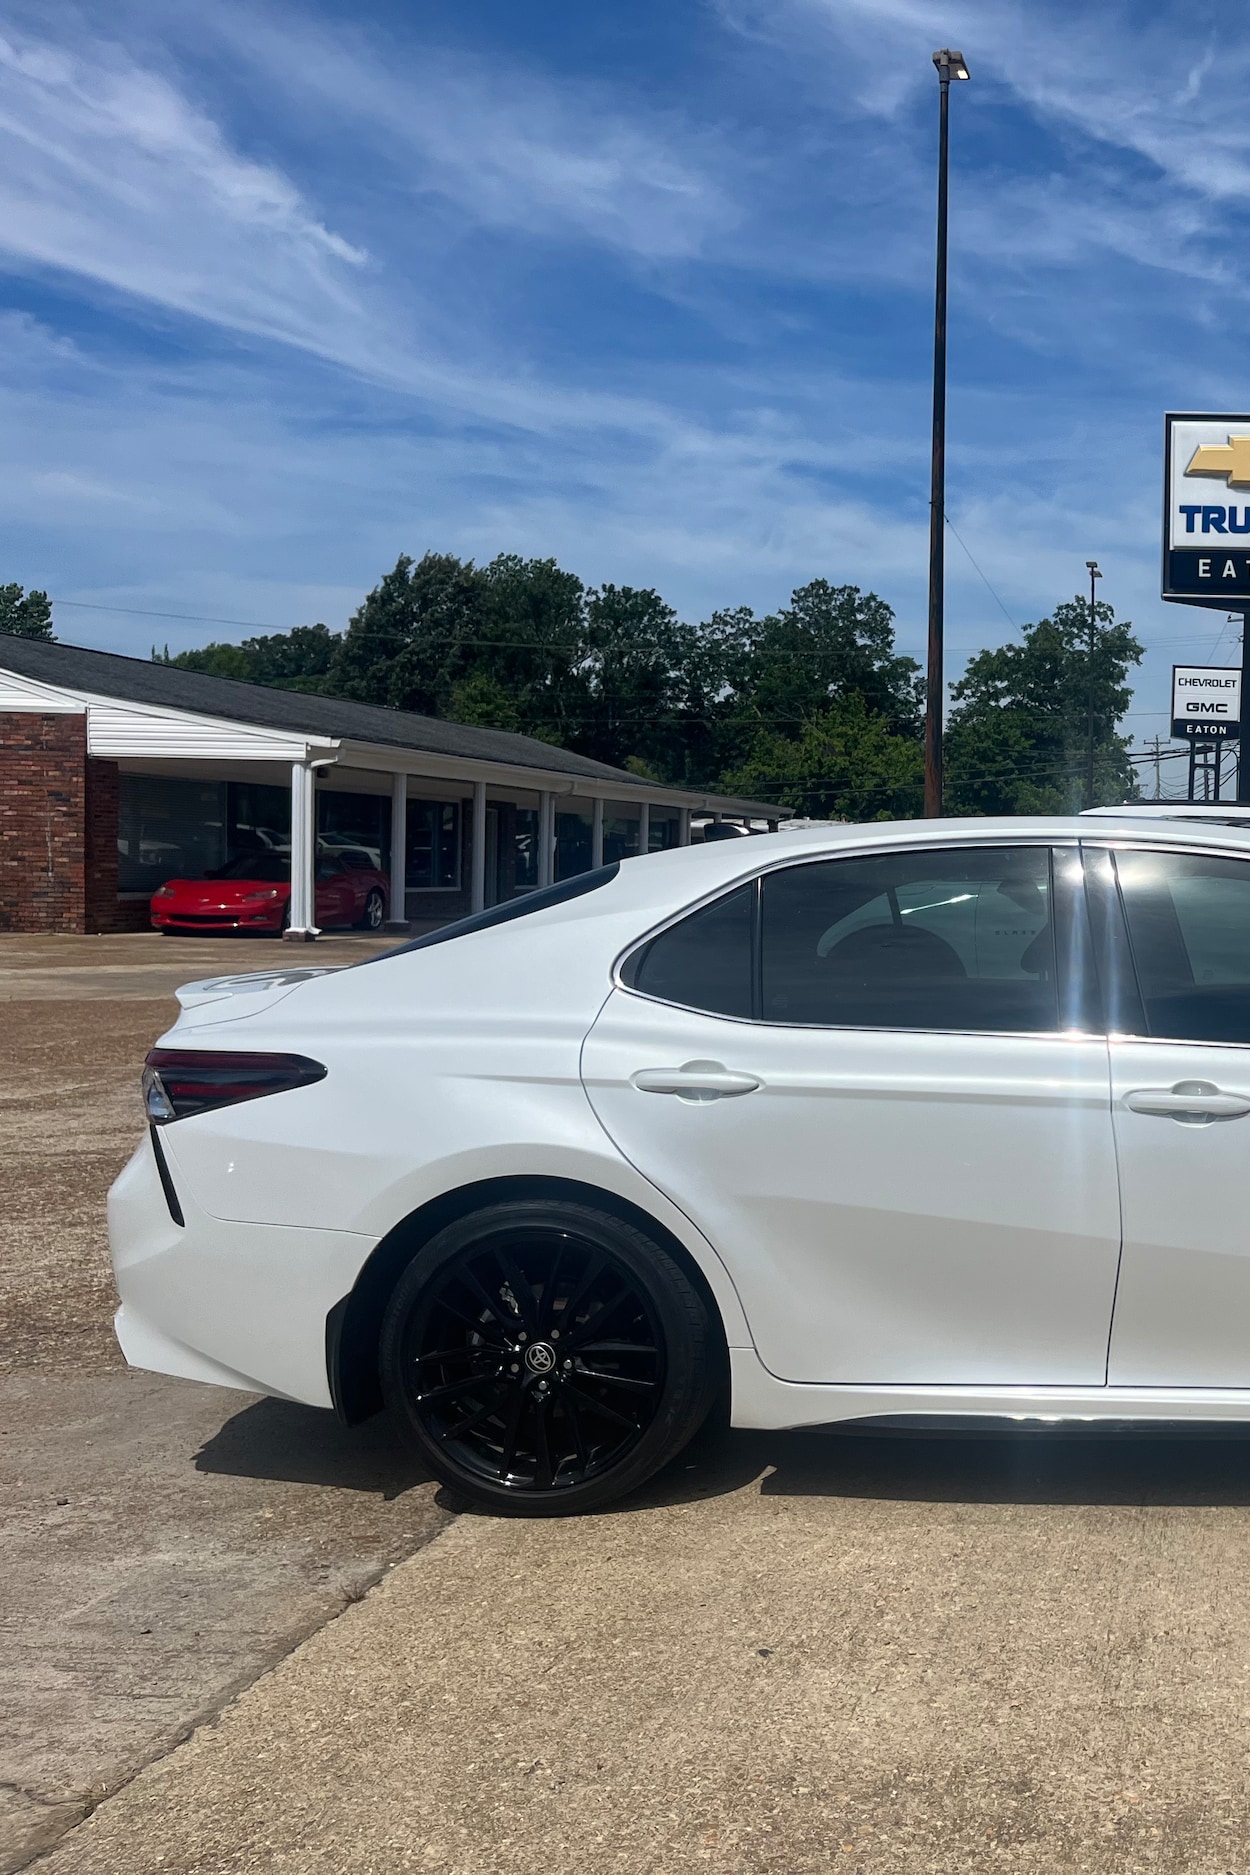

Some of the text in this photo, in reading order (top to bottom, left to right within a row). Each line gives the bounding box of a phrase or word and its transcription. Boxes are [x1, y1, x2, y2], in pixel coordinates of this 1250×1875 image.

[1178, 677, 1237, 688] CHEVROLET
[1186, 702, 1228, 712] GMC
[1186, 725, 1227, 734] EATON
